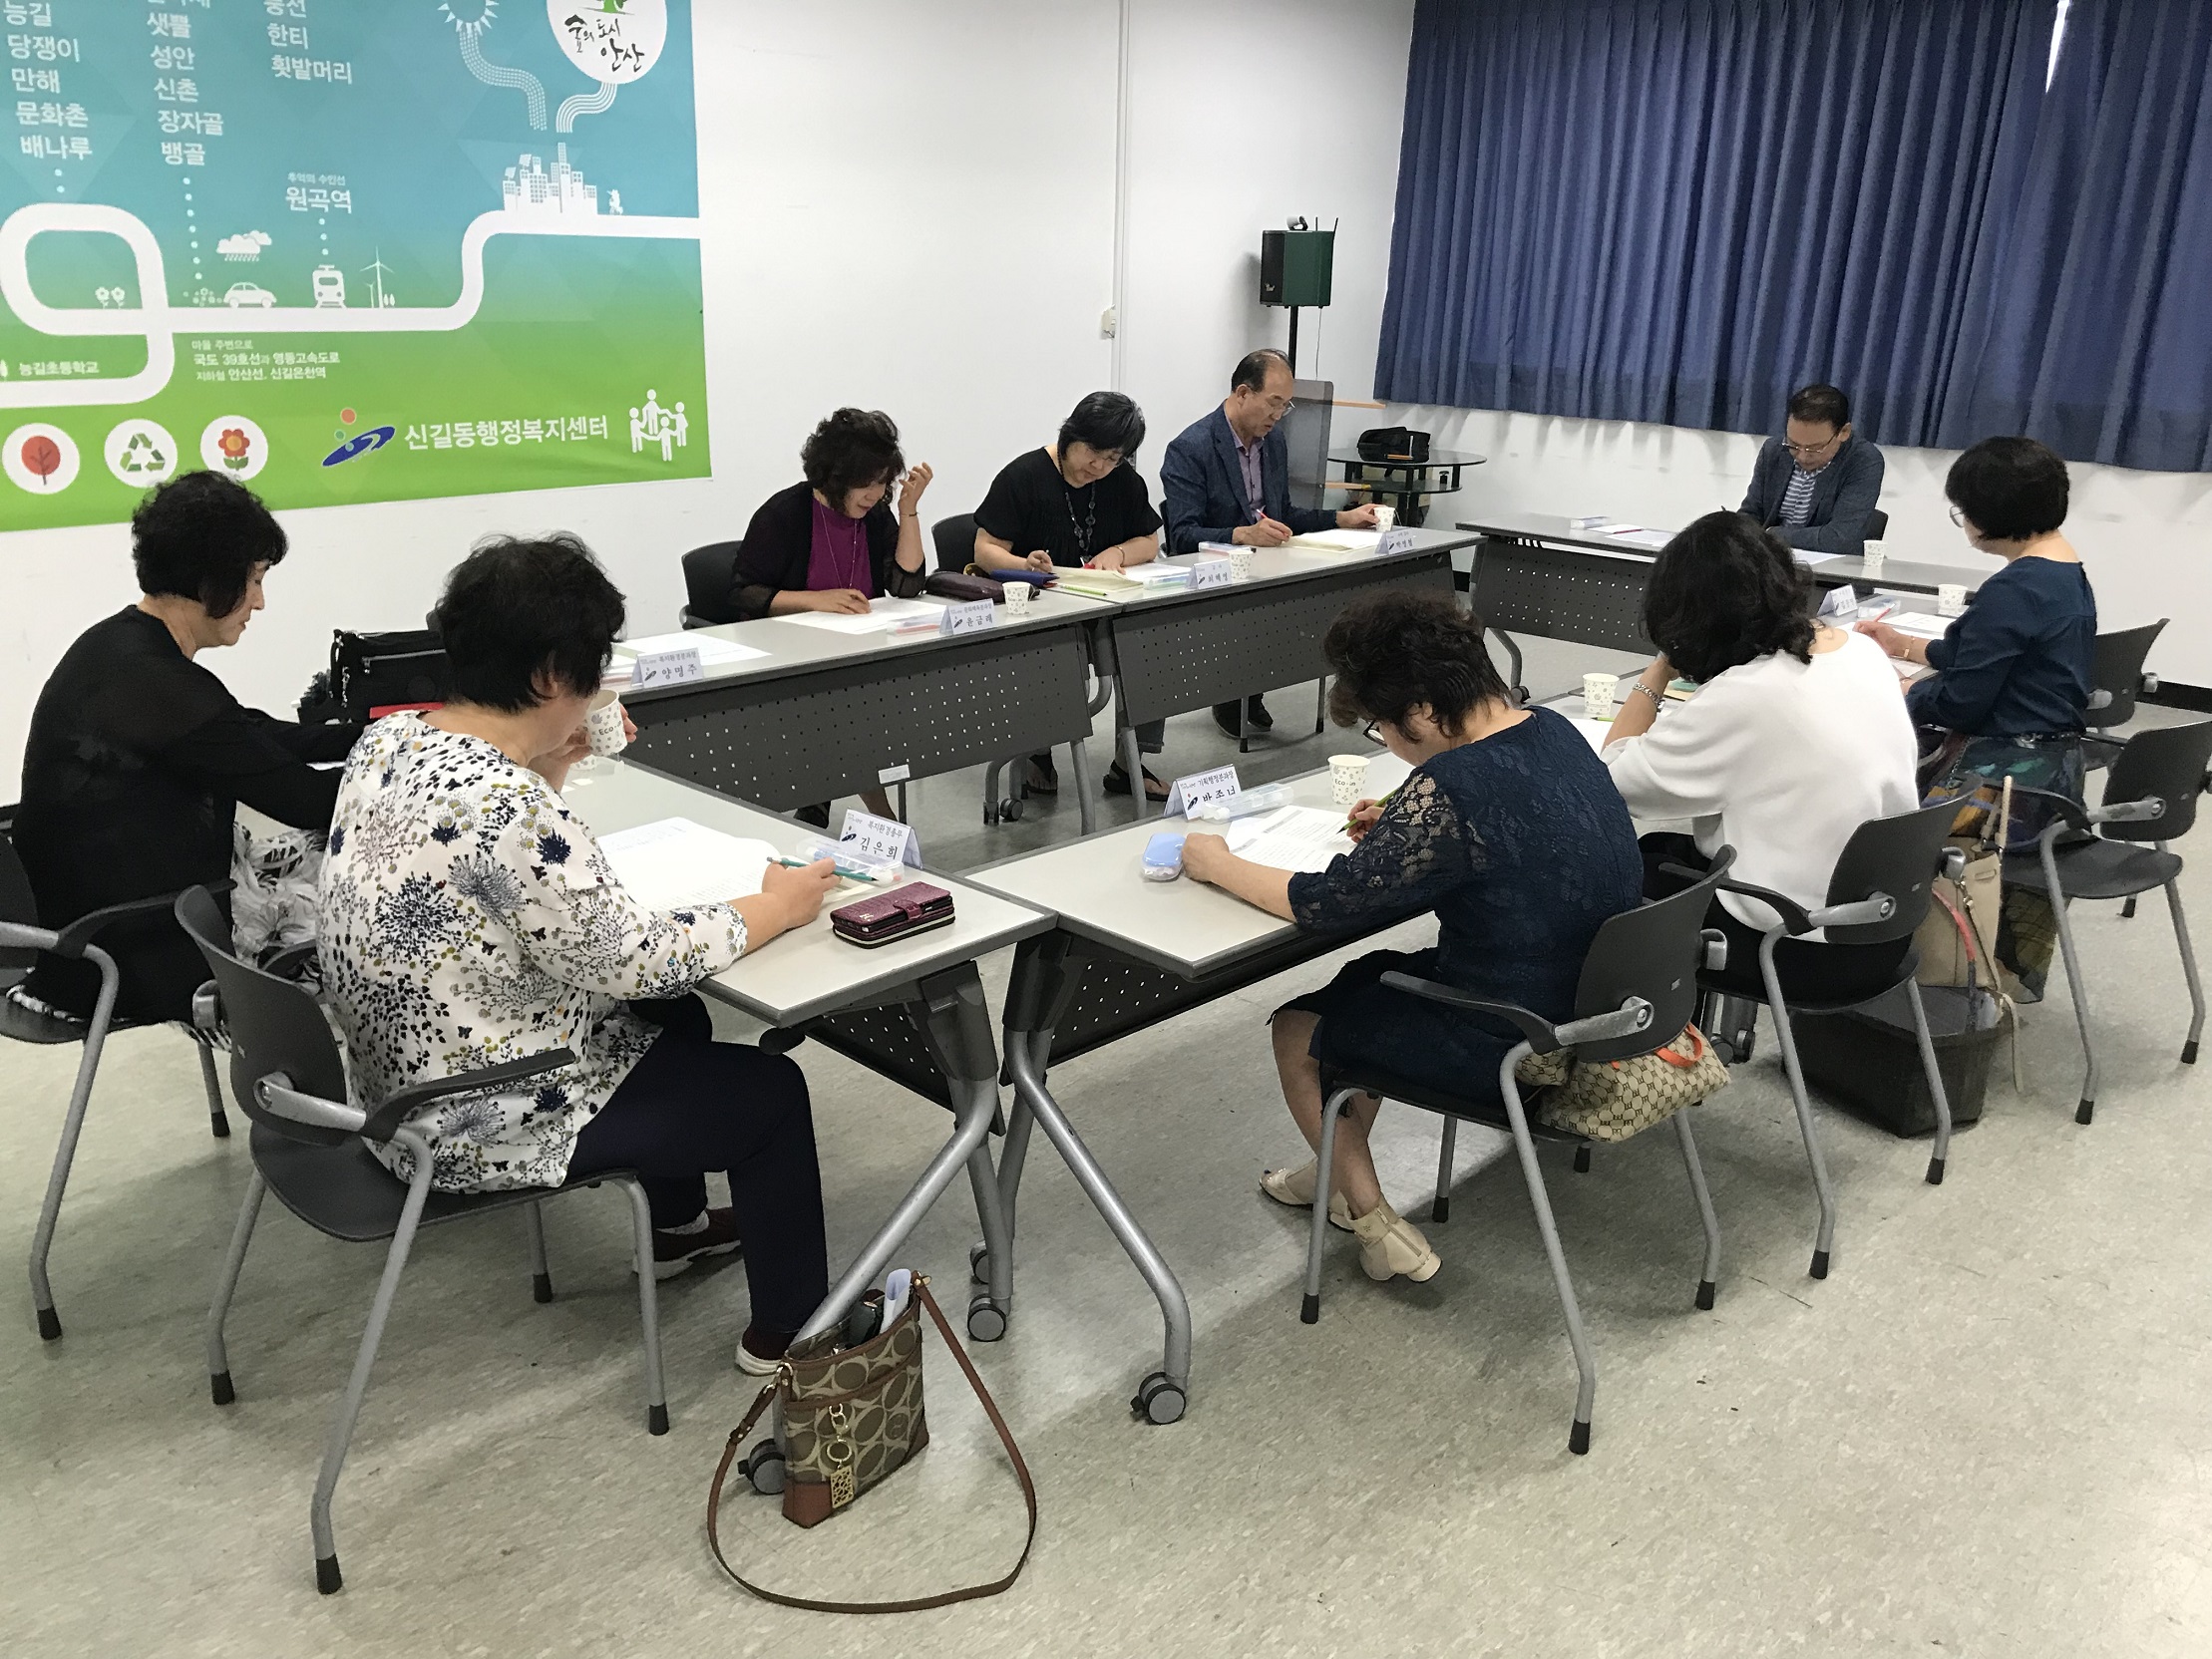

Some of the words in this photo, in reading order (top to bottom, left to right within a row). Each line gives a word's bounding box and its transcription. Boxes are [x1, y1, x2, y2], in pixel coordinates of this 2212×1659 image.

[7, 35, 81, 62] 당쟁이
[267, 22, 309, 50] 한티
[151, 46, 195, 71] 성안
[600, 37, 645, 73] 안산
[11, 68, 61, 94] 만해
[154, 78, 199, 103] 신촌
[16, 102, 89, 129] 문화촌
[158, 111, 224, 136] 장자골
[20, 135, 94, 161] 배나루
[161, 142, 206, 166] 뱅골
[285, 186, 352, 214] 원곡역
[193, 353, 219, 366] 국도
[272, 351, 341, 365] 영동고속도로
[270, 366, 327, 380] 신길온천역
[404, 415, 609, 451] 신길동행정복지센터
